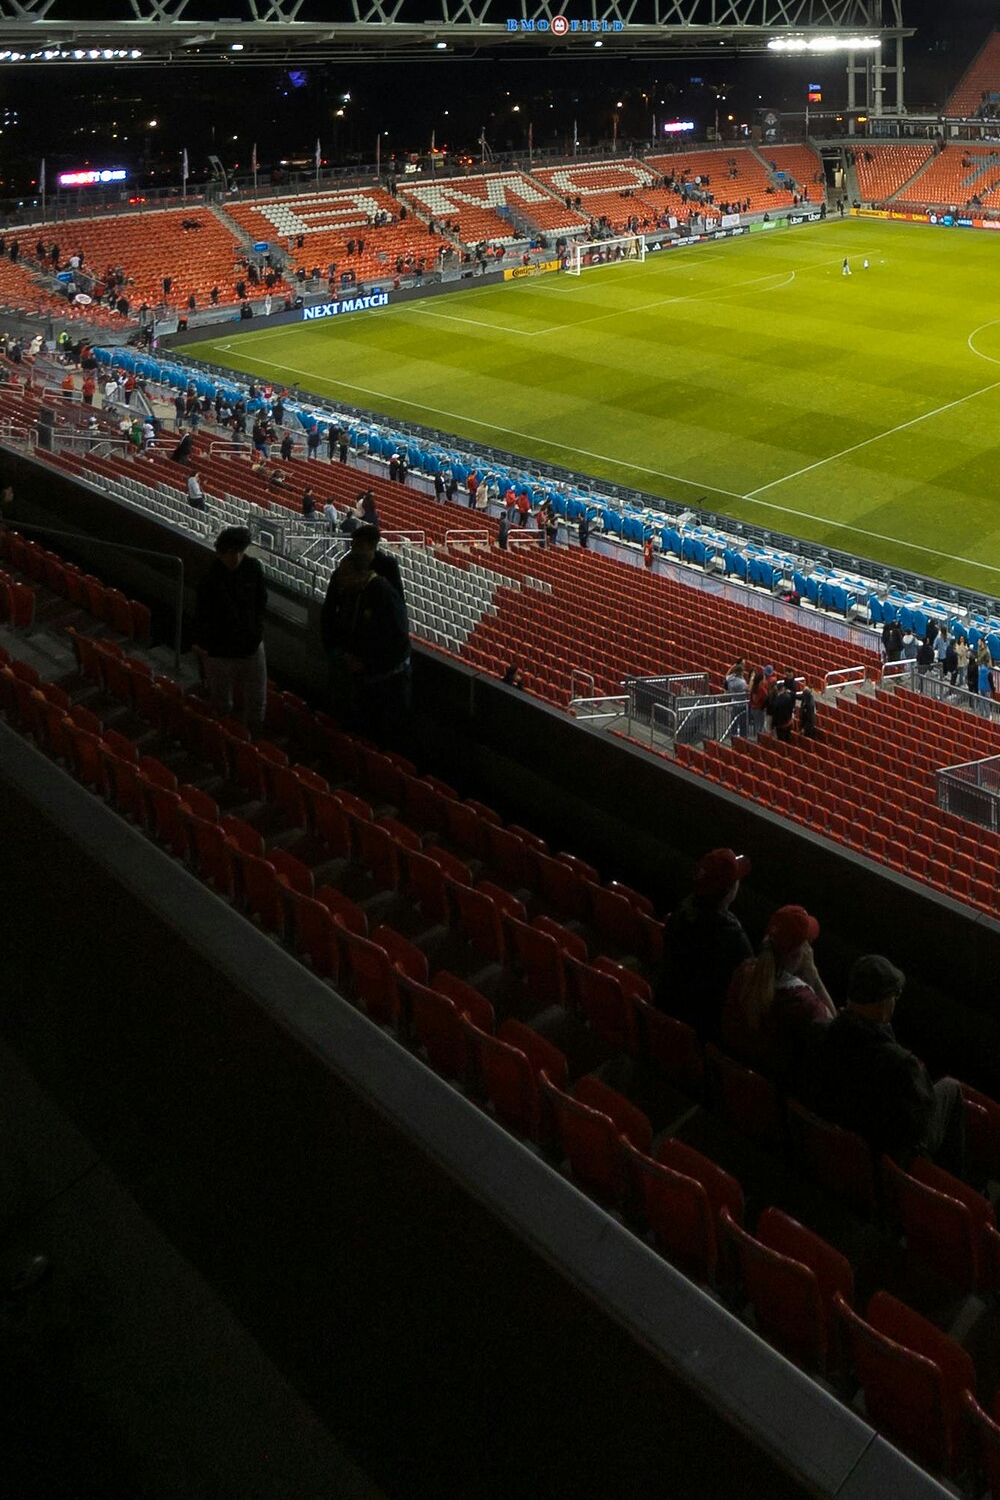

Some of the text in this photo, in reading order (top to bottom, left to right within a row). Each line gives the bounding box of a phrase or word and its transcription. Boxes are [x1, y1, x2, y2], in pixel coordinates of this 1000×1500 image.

[506, 19, 624, 31] BMO FIELD
[303, 293, 389, 320] NEXT MATCH
